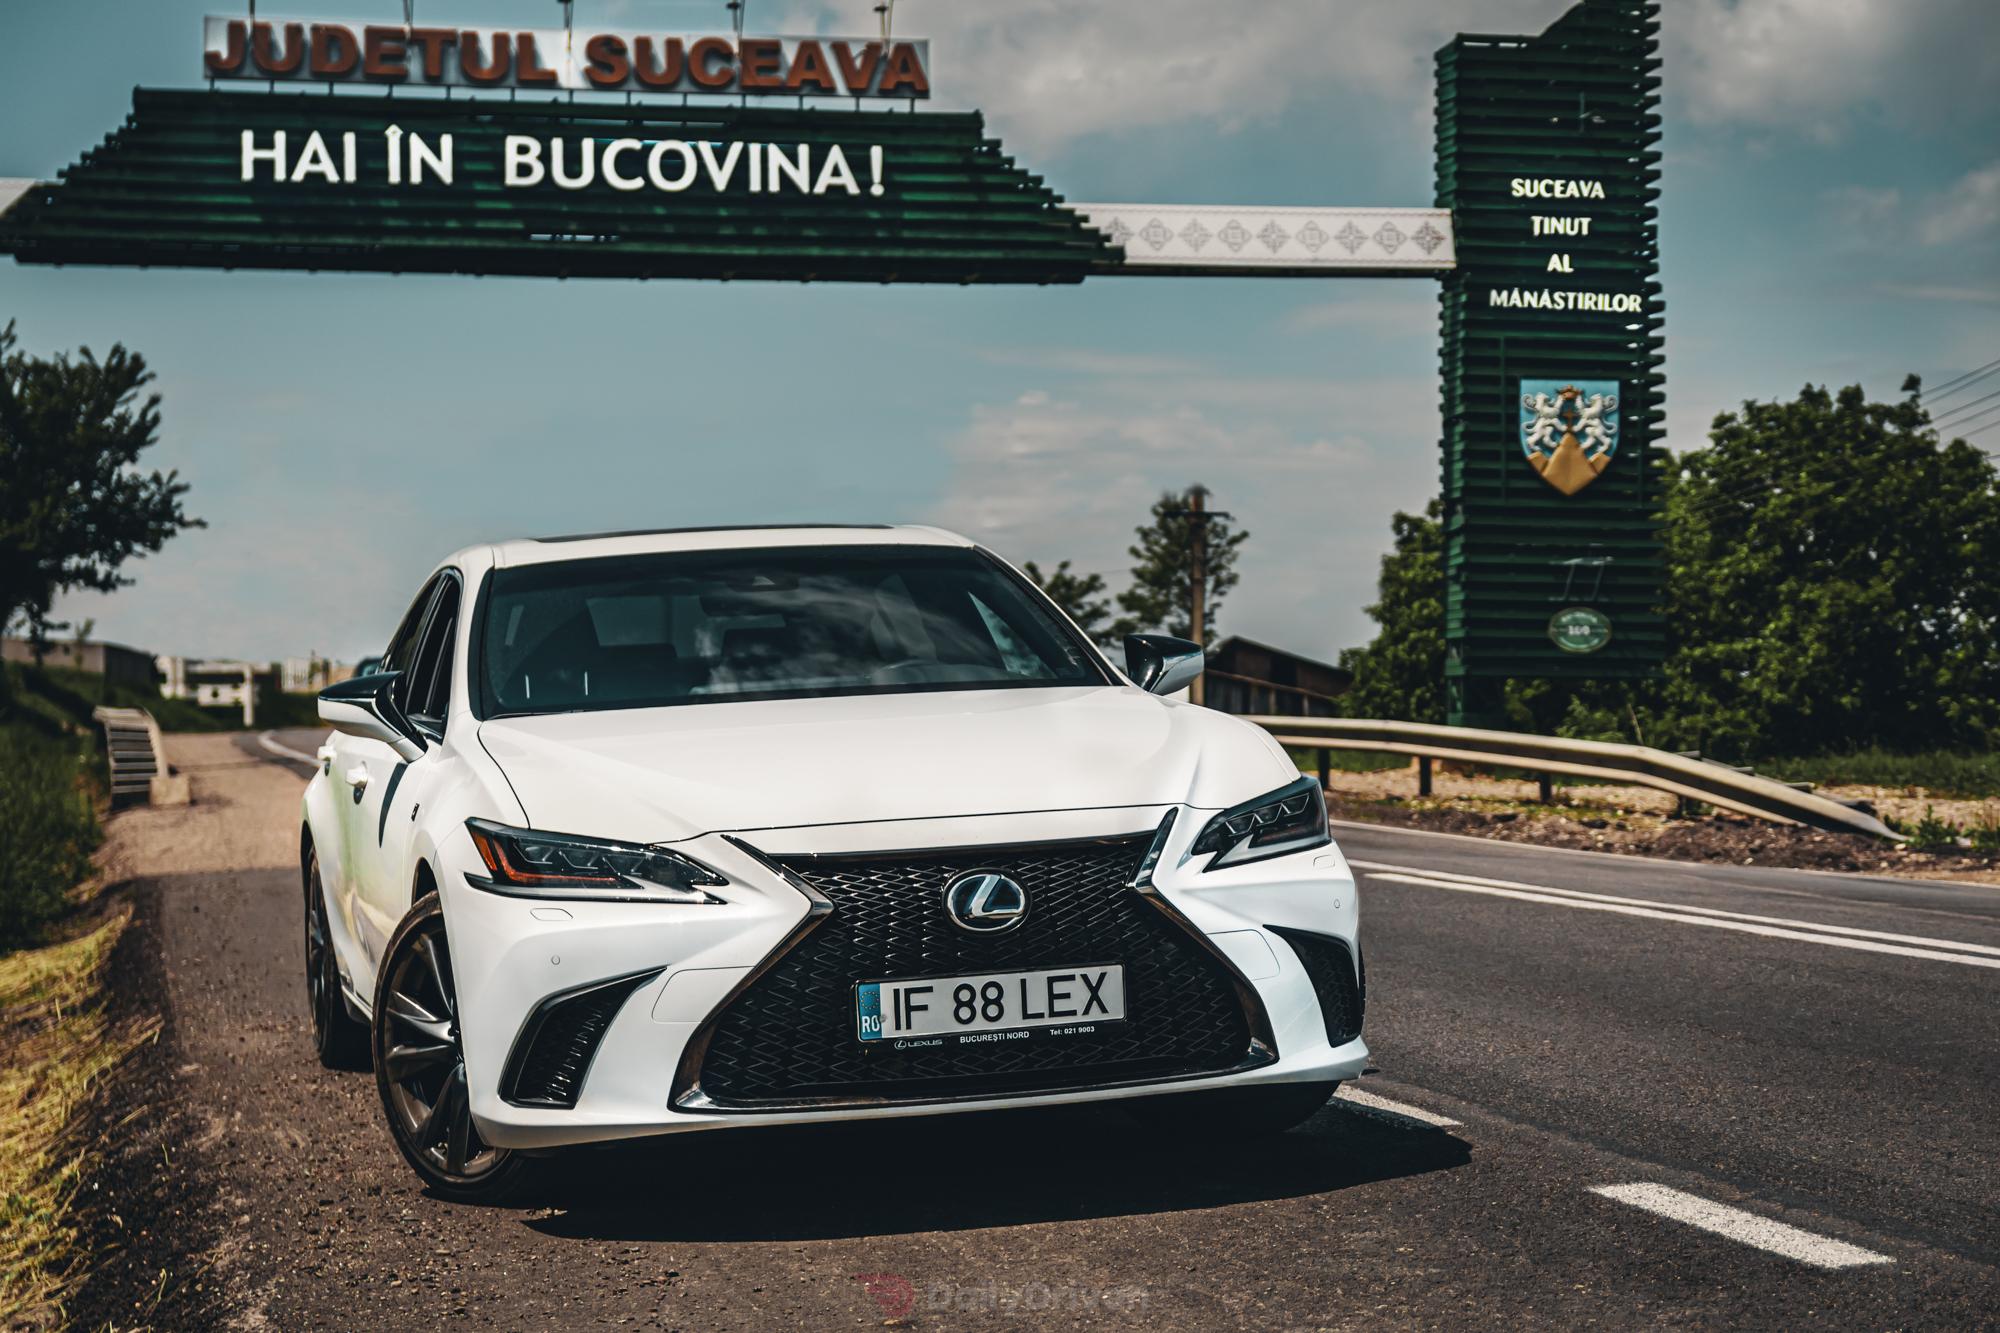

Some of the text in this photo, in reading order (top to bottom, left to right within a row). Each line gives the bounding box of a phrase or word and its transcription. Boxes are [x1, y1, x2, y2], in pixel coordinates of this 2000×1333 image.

[584, 34, 930, 93] SUCEAVA
[241, 124, 885, 197] HAI ÎN BUCOVINA!
[1511, 178, 1605, 199] SUCEAVA
[1547, 253, 1574, 273] AL
[861, 971, 1110, 1033] RO IF 88 LEX
[1007, 1030, 1030, 1040] NORD
[1064, 1027, 1076, 1035] 021
[1078, 1026, 1095, 1034] 9003
[907, 1038, 943, 1048] LEXUS
